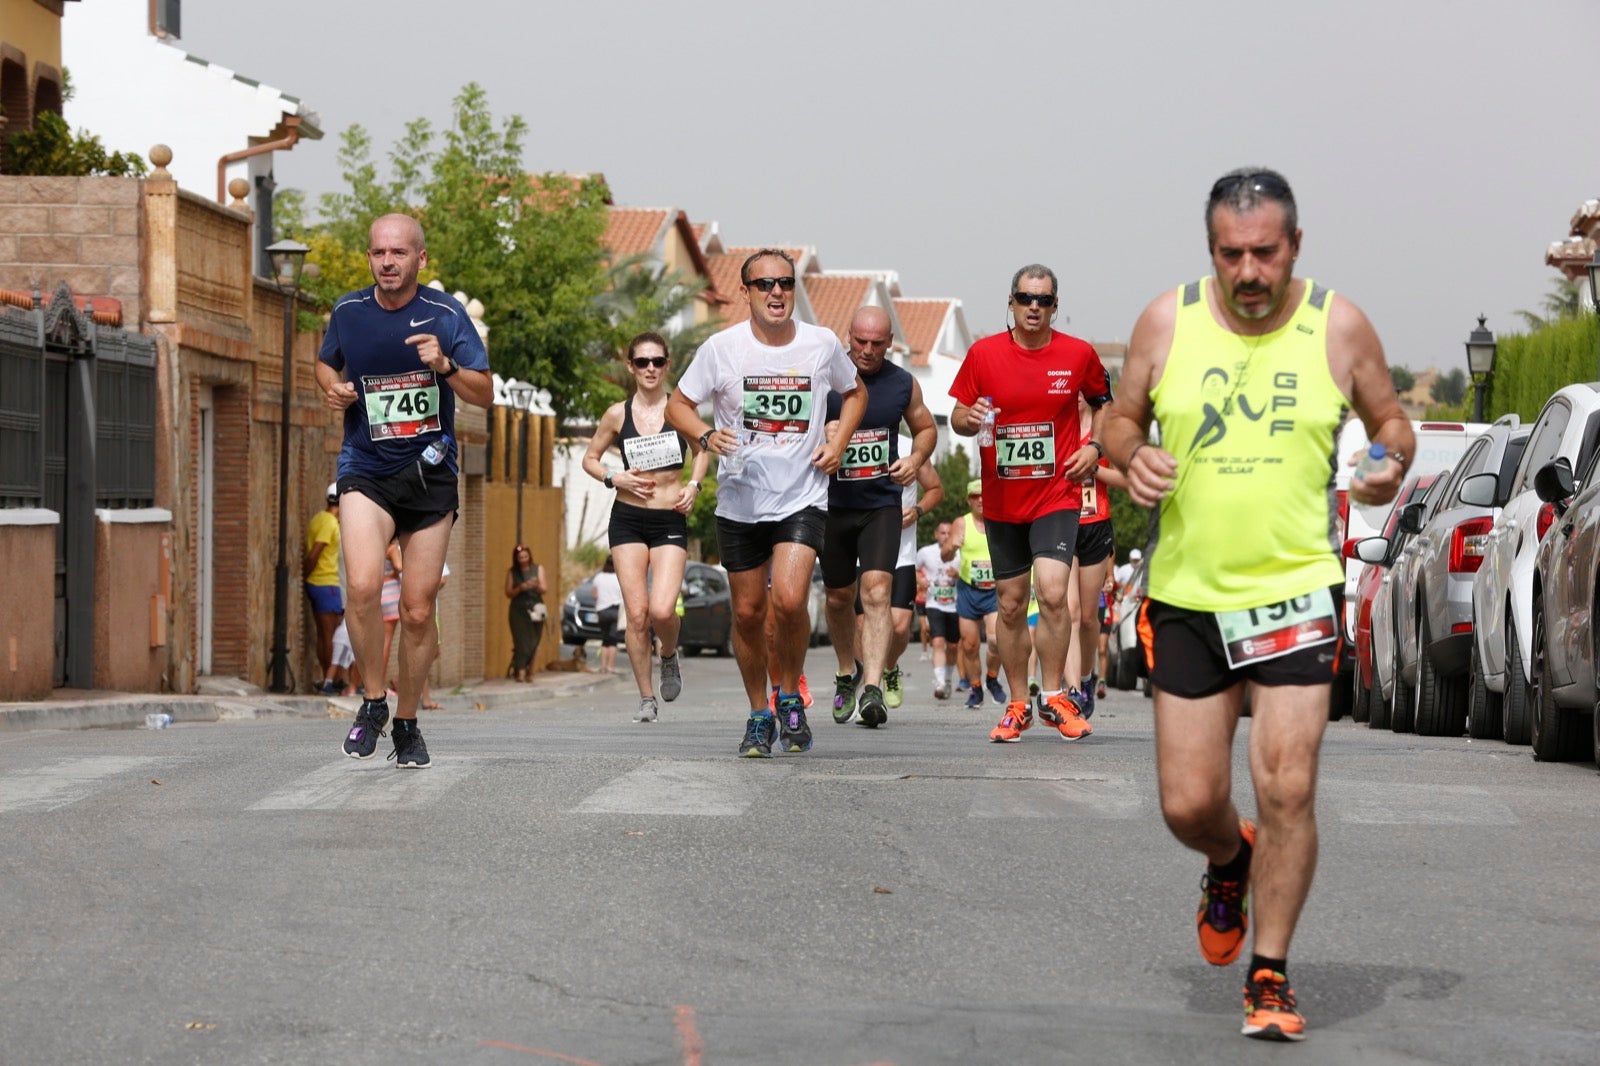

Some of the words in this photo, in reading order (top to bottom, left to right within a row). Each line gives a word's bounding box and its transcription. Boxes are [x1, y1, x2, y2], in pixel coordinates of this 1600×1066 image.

[379, 391, 430, 417] 746
[755, 394, 802, 415] 350
[845, 445, 882, 464] 260
[1005, 440, 1045, 461] 748
